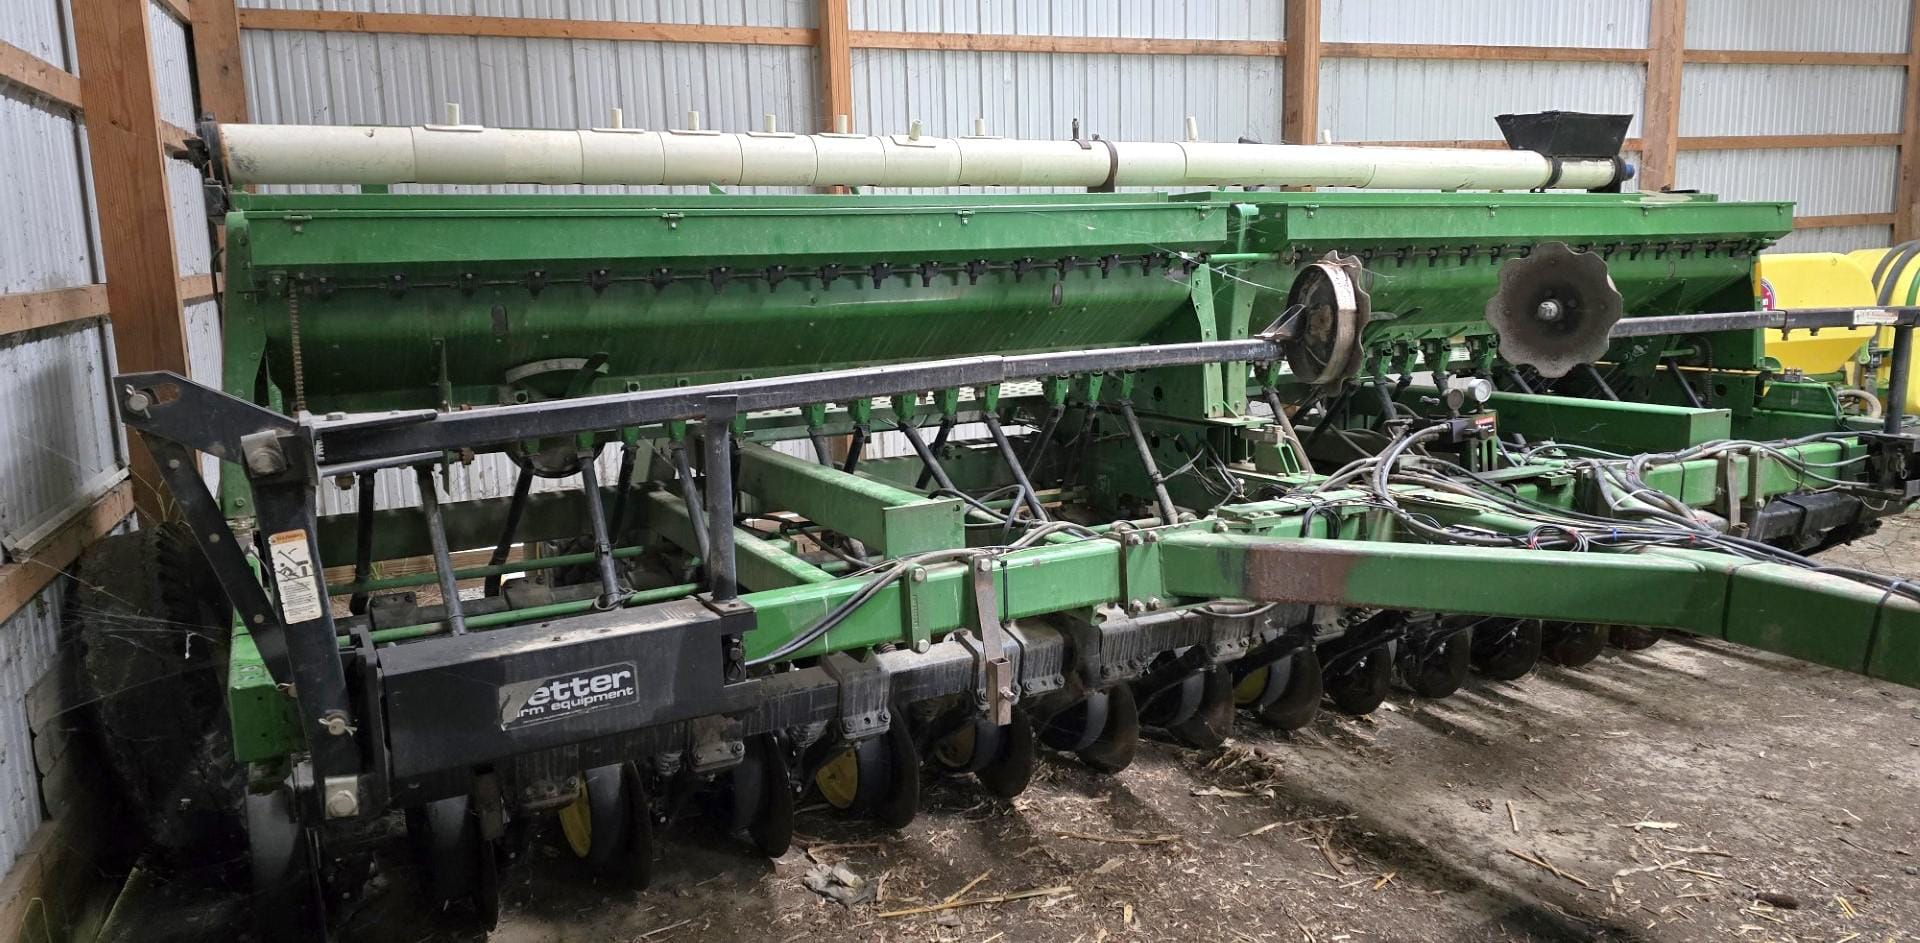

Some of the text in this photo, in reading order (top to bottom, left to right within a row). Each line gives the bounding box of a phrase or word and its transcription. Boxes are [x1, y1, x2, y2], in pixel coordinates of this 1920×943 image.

[516, 686, 634, 718] rm equipment
[527, 670, 631, 706] etter
